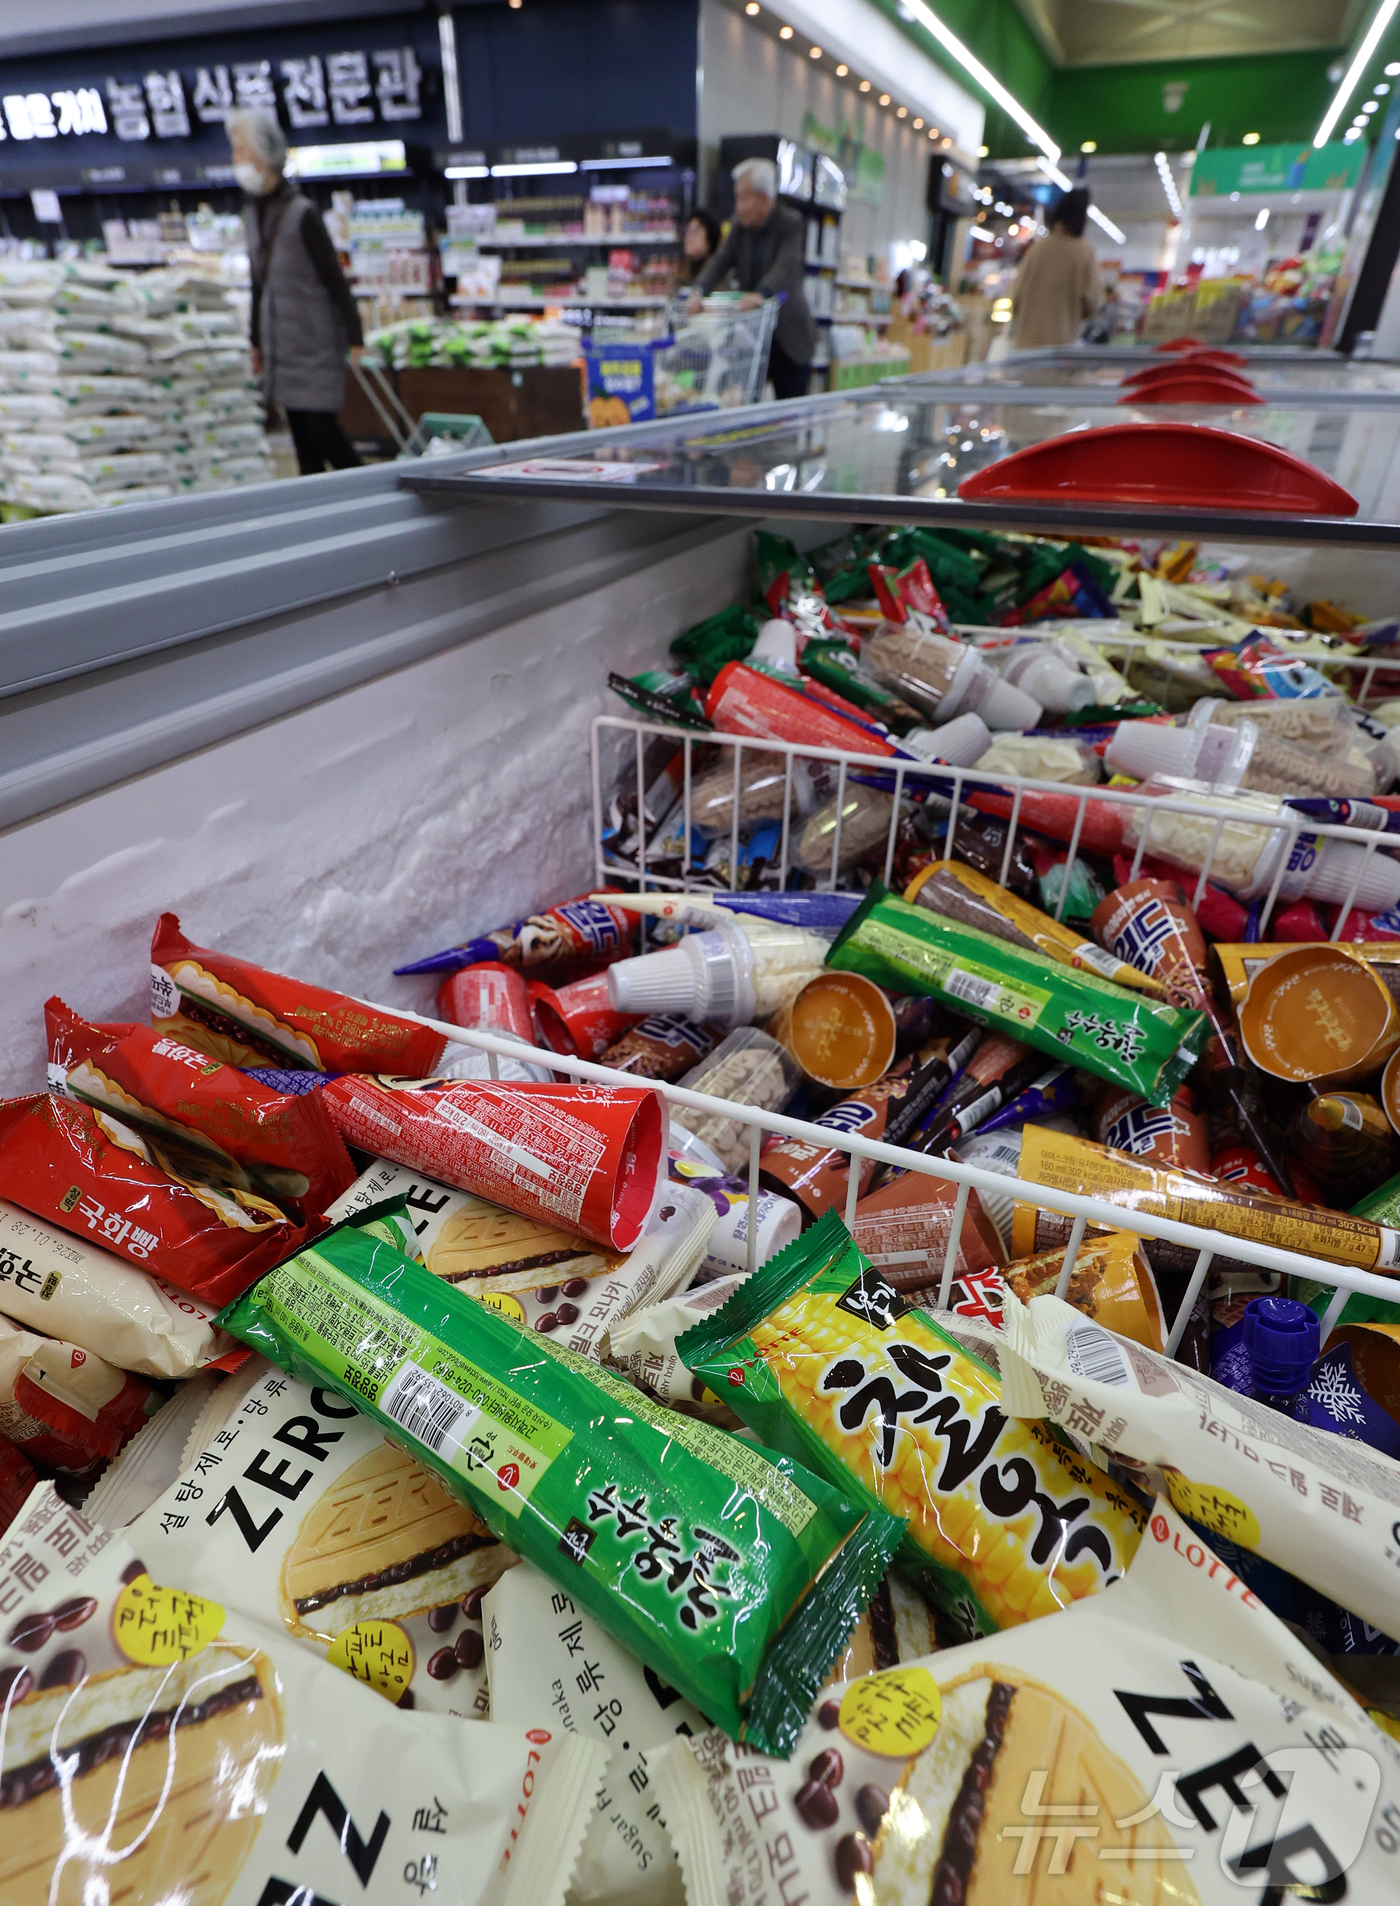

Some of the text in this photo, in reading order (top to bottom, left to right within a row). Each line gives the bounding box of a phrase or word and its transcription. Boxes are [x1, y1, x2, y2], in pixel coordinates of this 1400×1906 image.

[106, 74, 190, 141] 농협
[280, 46, 422, 129] 전문관
[1061, 1004, 1151, 1068] 찰옥수수
[151, 1037, 209, 1070] 국화빵
[437, 1102, 455, 1118] kcal
[452, 1097, 462, 1107] 25
[463, 1104, 474, 1114] 25
[475, 1097, 498, 1116] 포화지방
[452, 1111, 468, 1126] 270
[471, 1108, 485, 1122] 당류
[488, 1119, 499, 1130] 11
[508, 1119, 521, 1130] 0.5
[470, 1122, 479, 1131] ml
[476, 1126, 489, 1139] 160
[501, 1127, 512, 1138] 35
[505, 1104, 598, 1163] 콜레스테롤 20 mg 7 단백질 5 9
[518, 1123, 549, 1147] 트랜스지방
[553, 1146, 564, 1156] 22
[557, 1161, 569, 1172] 95
[566, 1166, 589, 1184] 나트륨
[1039, 1160, 1053, 1171] 160
[546, 1166, 584, 1197] 영양정보
[77, 1190, 160, 1261] 국화빵
[1241, 1225, 1247, 1234] 8
[1295, 1220, 1304, 1228] 12
[1351, 1233, 1362, 1242] 23
[1311, 1213, 1326, 1223] 160
[1336, 1218, 1354, 1230] 302
[1355, 1223, 1377, 1236] kcal
[1312, 1233, 1340, 1247] 포화지방
[1355, 1243, 1365, 1252] 47
[280, 1275, 292, 1288] 4.8
[311, 1282, 320, 1292] 4
[287, 1281, 309, 1303] 포화지방
[320, 1290, 328, 1298] 2
[322, 1291, 345, 1312] 단백질
[318, 1306, 332, 1319] 0.5
[350, 1312, 358, 1322] 5
[355, 1315, 368, 1328] mg
[565, 1276, 627, 1356] 밀크 모나카
[326, 1313, 357, 1341] 트랜스지방
[282, 1295, 390, 1383] 나트륨 95 5 탄수화물 23 7 당류
[744, 1327, 806, 1370] LOTTE
[278, 1311, 381, 1401] 영양정보 내용량 140
[435, 1386, 465, 1411] 801062
[507, 1394, 523, 1409] 부담)
[520, 1403, 535, 1416] 요금
[1060, 1392, 1109, 1442] 제로
[532, 1411, 553, 1429] (수신자
[485, 1429, 498, 1440] PP
[713, 1431, 732, 1447] 국번
[505, 1443, 538, 1469] 롯데웰푸드
[730, 1442, 758, 1465] 신고는
[1318, 1480, 1366, 1525] 제로
[585, 1486, 741, 1631] 찰옥수수
[1173, 1533, 1263, 1612] LOTTE
[380, 1649, 408, 1687] 앙금
[609, 1812, 653, 1871] Sugar
